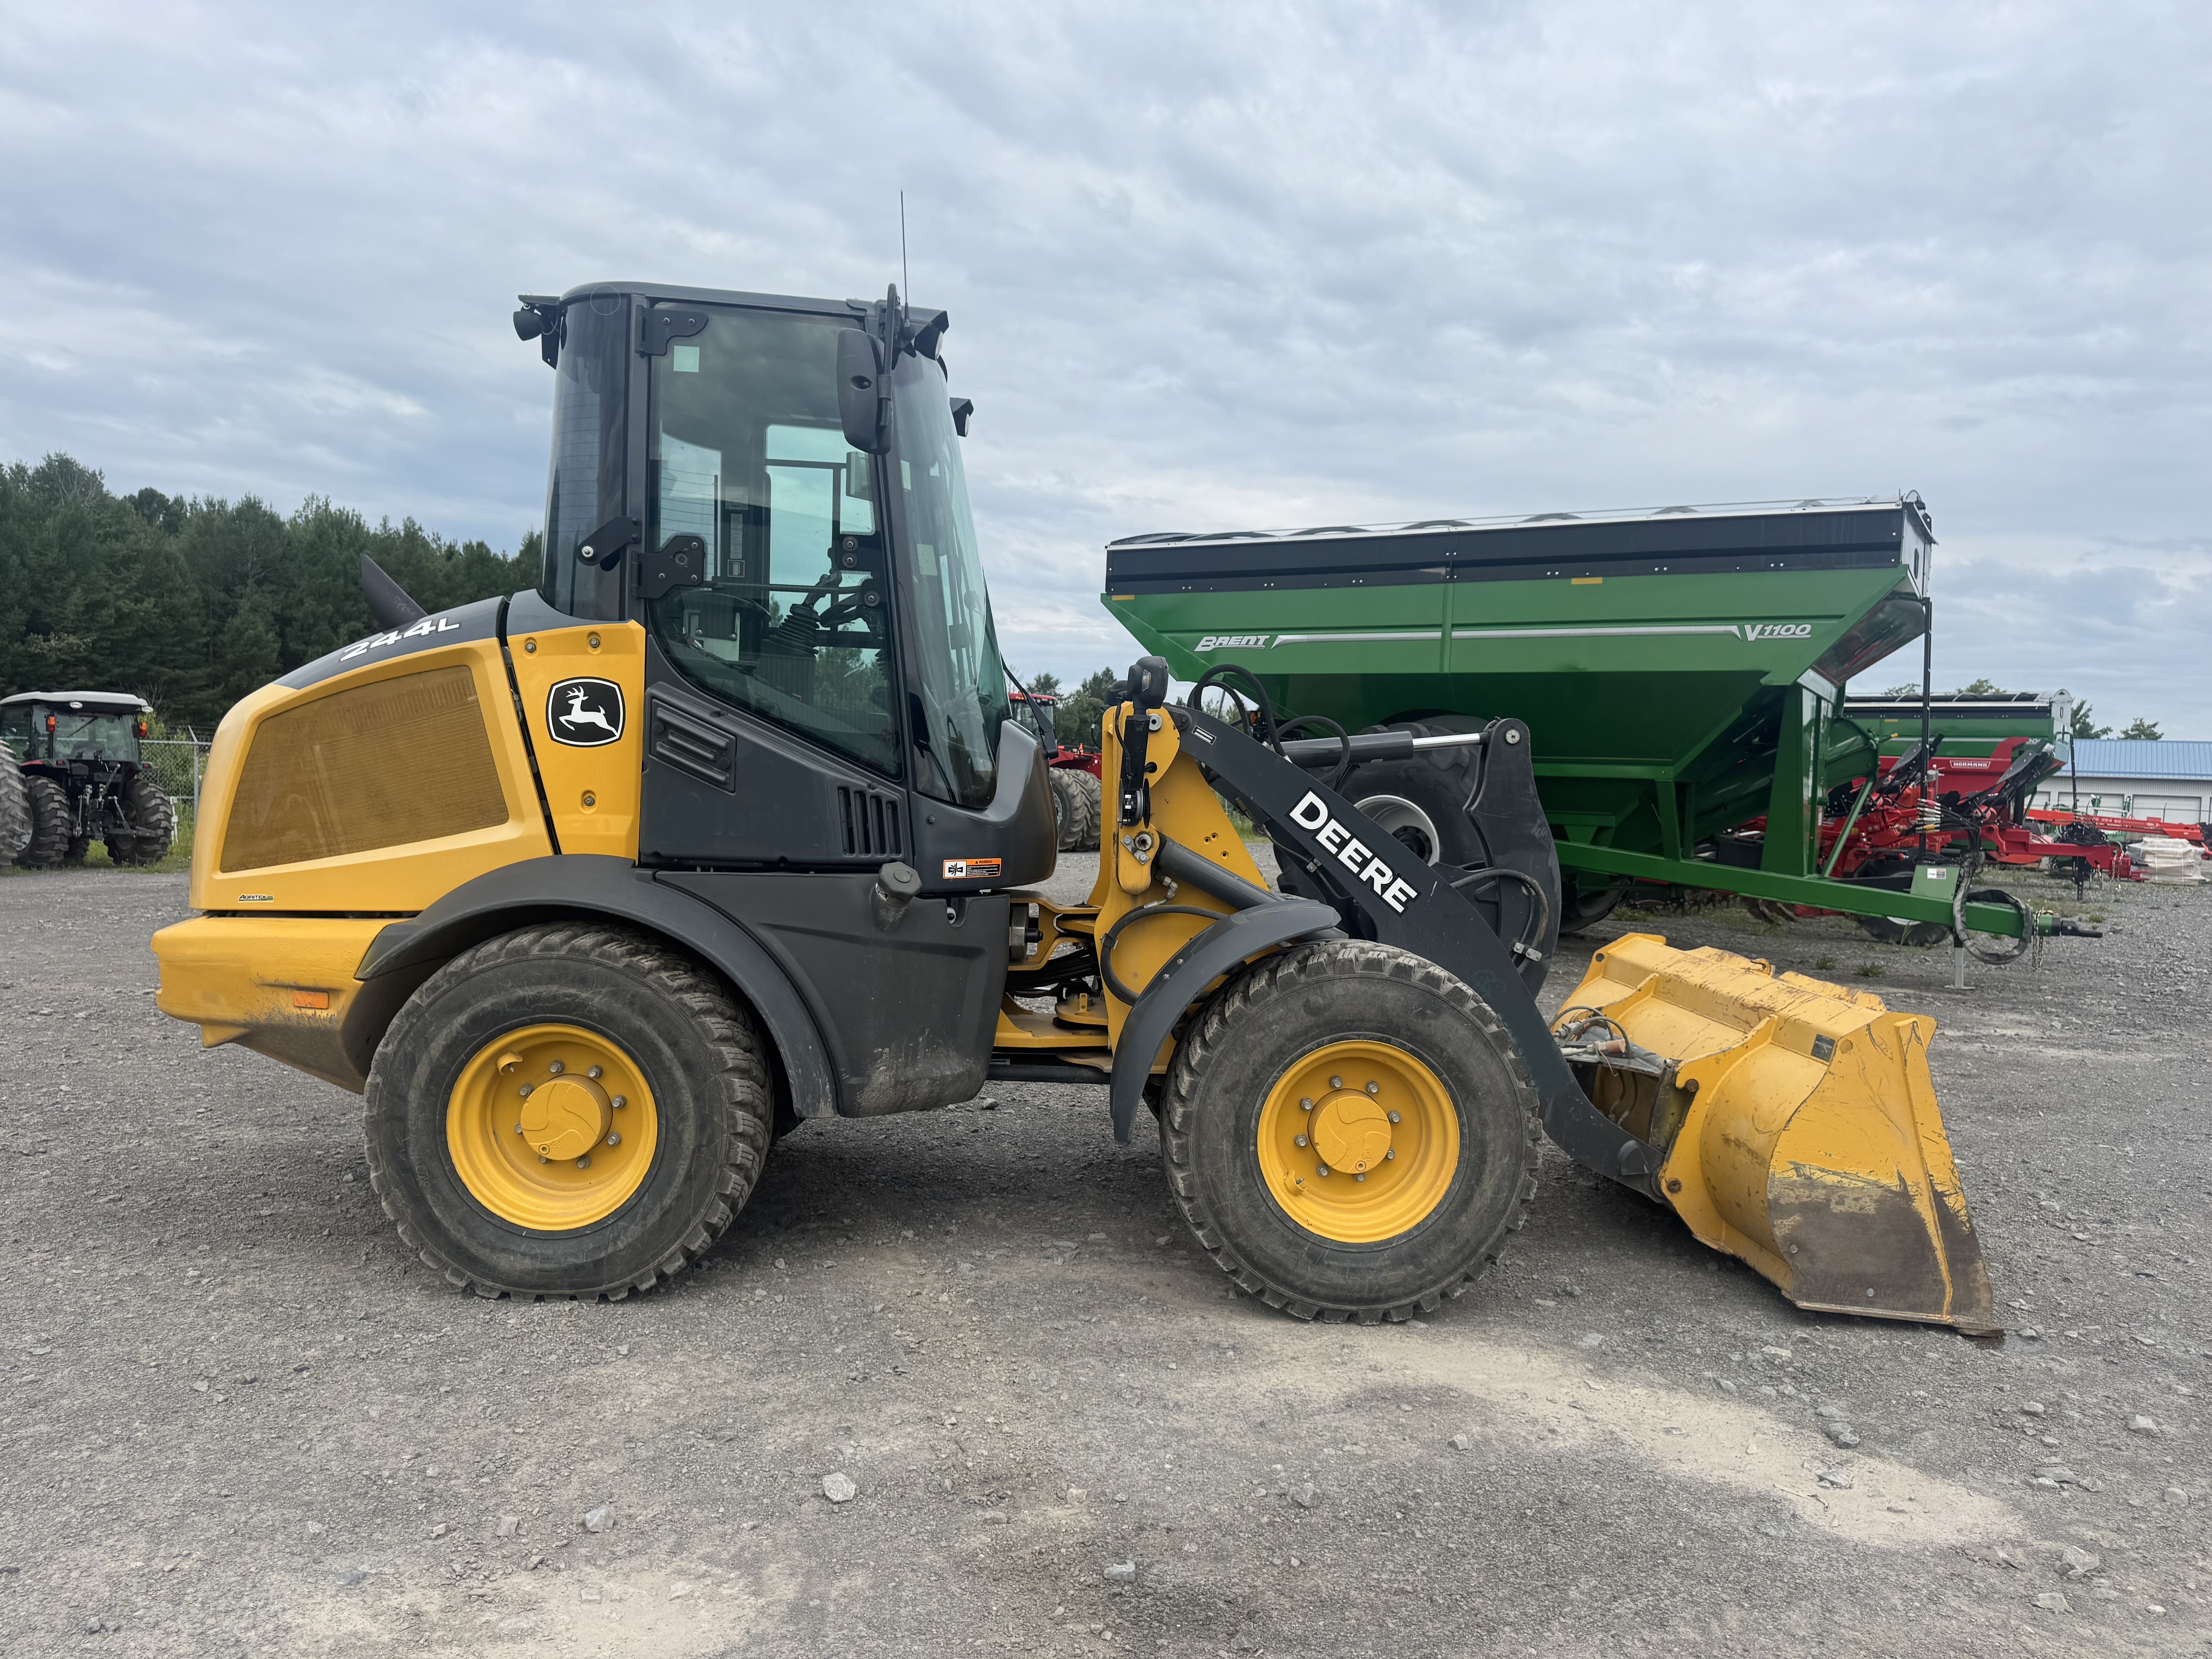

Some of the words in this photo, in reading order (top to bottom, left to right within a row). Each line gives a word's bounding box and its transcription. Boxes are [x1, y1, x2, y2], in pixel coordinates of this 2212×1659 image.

[340, 618, 460, 661] 244L
[1194, 635, 1271, 652] BRENT
[1744, 624, 1812, 641] V1100
[1290, 791, 1418, 913] DEERE
